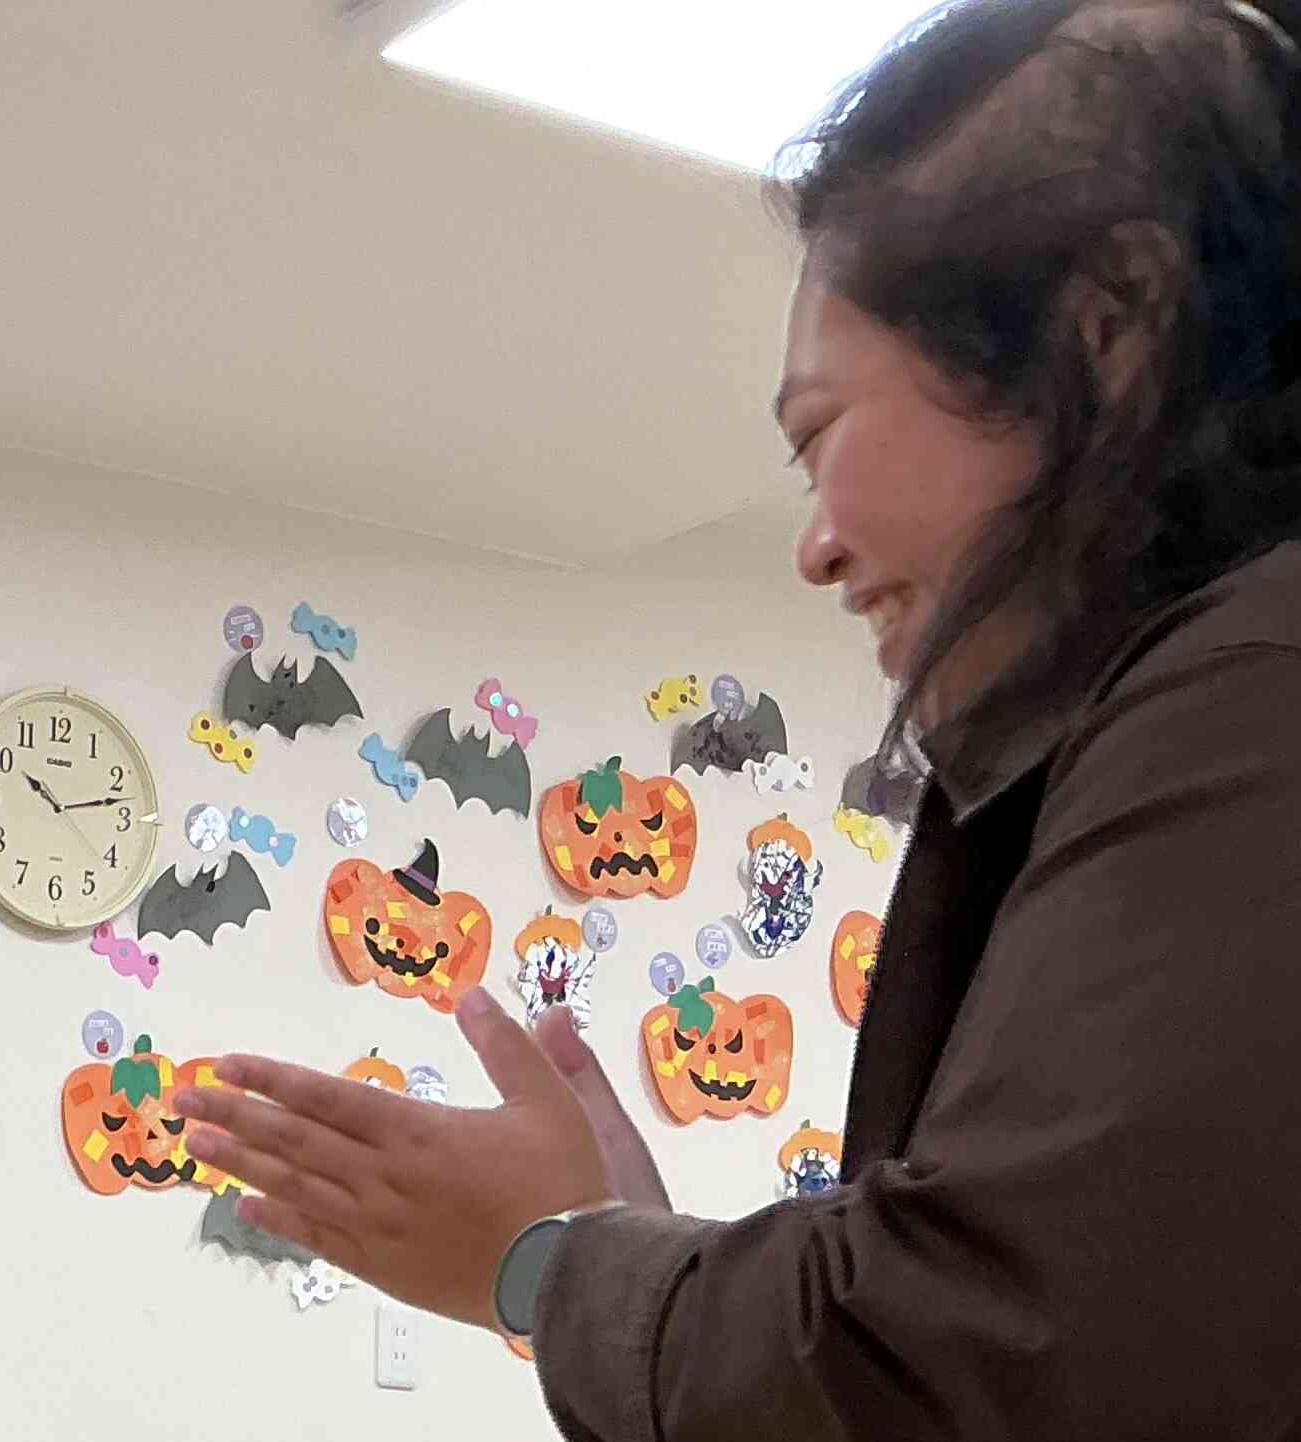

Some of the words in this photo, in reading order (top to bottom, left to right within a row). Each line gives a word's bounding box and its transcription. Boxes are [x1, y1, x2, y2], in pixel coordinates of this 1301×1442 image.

[17, 719, 35, 749] 11
[49, 716, 72, 743] 12
[89, 733, 98, 759] 1
[110, 766, 124, 792] 2
[116, 807, 131, 832] 3
[103, 843, 118, 868] 4
[15, 859, 29, 885] 7
[81, 870, 96, 896] 5
[48, 875, 62, 901] 6
